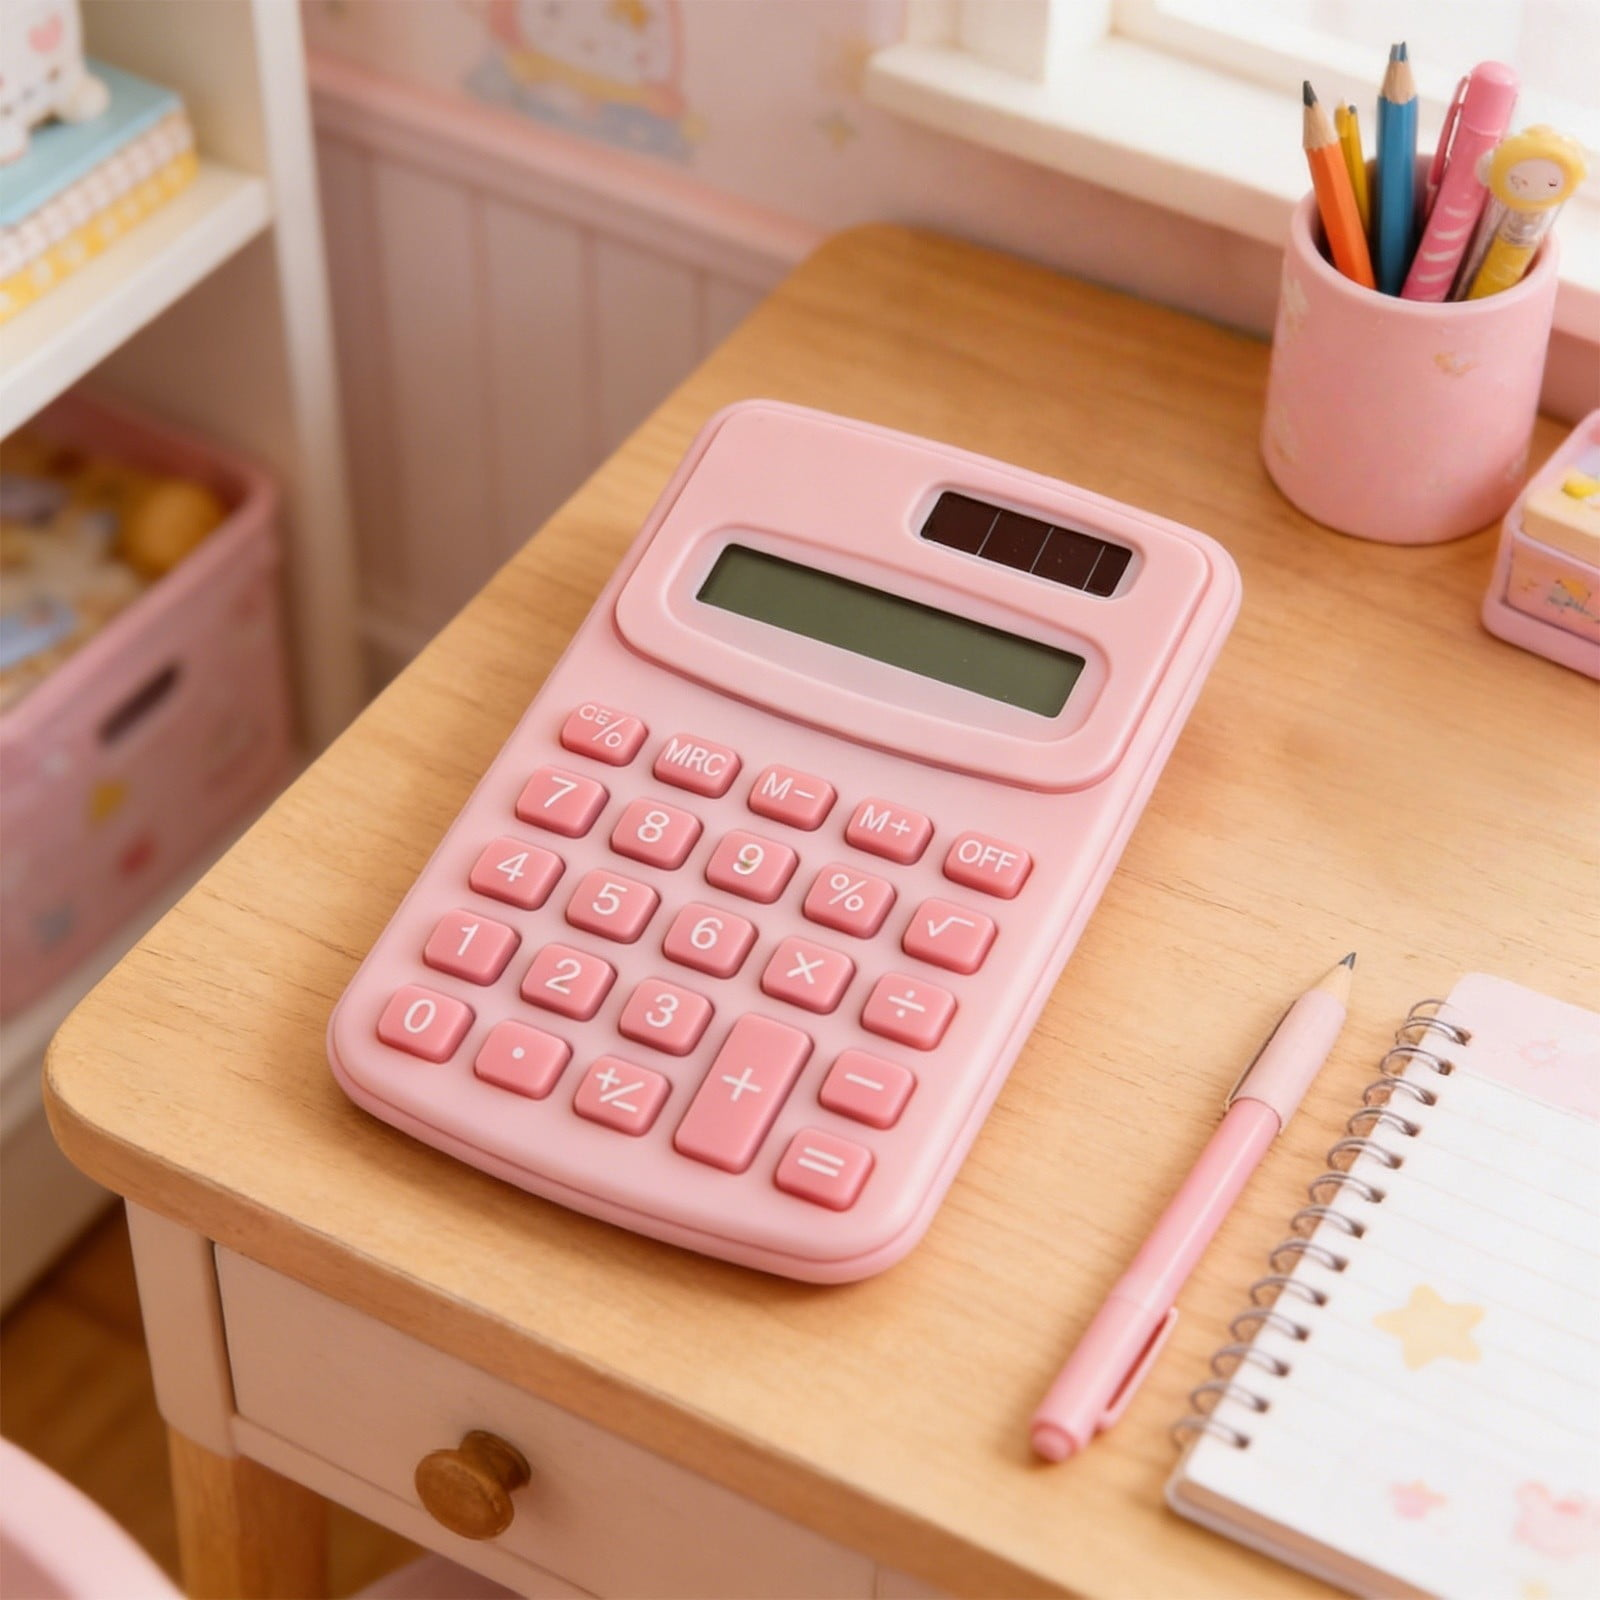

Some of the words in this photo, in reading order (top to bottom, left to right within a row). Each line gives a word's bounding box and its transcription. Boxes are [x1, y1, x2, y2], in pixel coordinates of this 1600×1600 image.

[664, 738, 727, 777] MRC
[543, 776, 578, 809] 7
[637, 810, 670, 843] 8
[858, 804, 911, 836] M+
[496, 852, 529, 883] 4
[732, 843, 765, 875] 9
[958, 839, 1018, 873] OFF
[591, 882, 628, 916] 5
[828, 873, 867, 912] %
[457, 923, 480, 957] 1
[690, 917, 724, 950] 6
[544, 958, 582, 995] 2
[403, 999, 437, 1034] 0
[645, 993, 680, 1028] 3
[888, 989, 926, 1019] ÷
[721, 1067, 762, 1102] +
[797, 1146, 845, 1178] =
